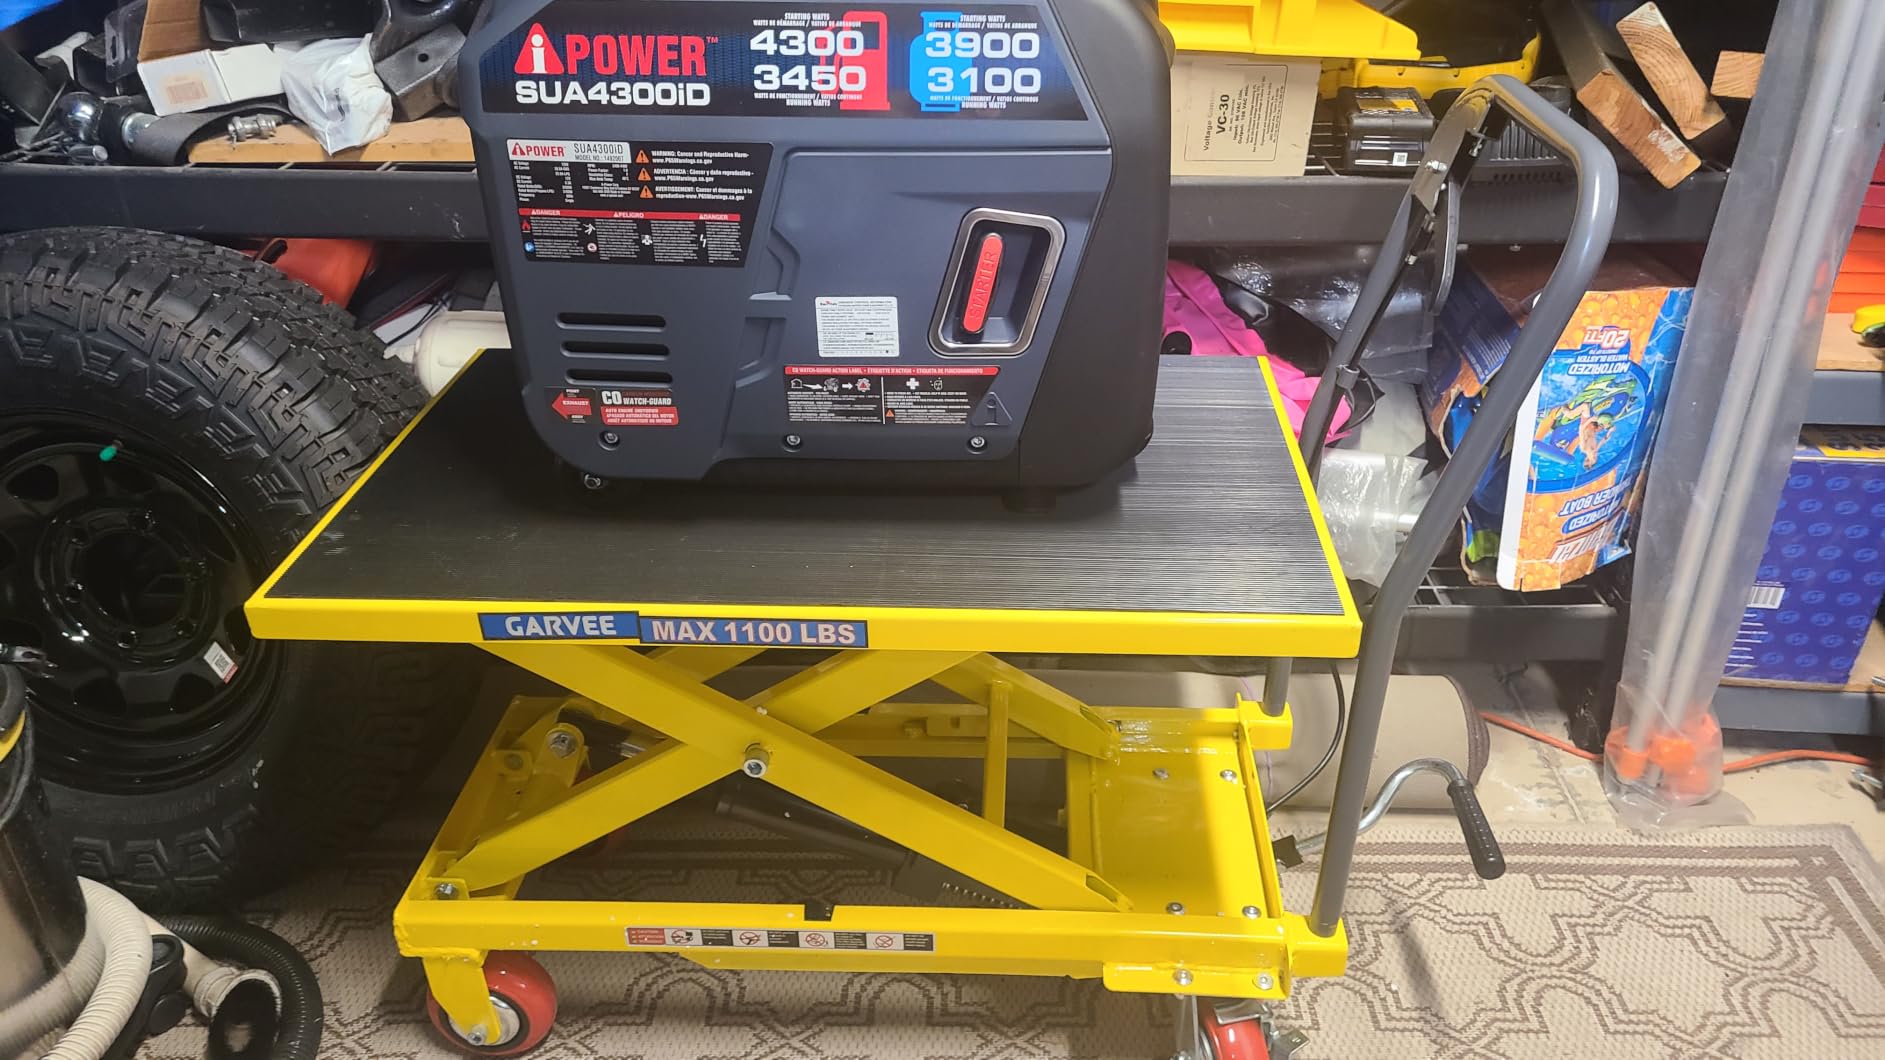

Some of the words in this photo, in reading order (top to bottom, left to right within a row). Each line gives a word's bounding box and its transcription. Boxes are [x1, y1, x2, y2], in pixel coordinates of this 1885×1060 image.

[784, 12, 811, 20] STARTING
[750, 29, 864, 56] 4300
[925, 32, 1040, 59] 3900
[753, 64, 866, 92] 3450
[928, 67, 1041, 93] 3100
[515, 80, 711, 106] SUA4300iD
[813, 99, 831, 107] WATTS
[961, 101, 988, 109] RUNNING
[988, 101, 1007, 109] WATTS
[1216, 94, 1230, 134] VC-30
[1203, 120, 1213, 151] Voltage
[574, 143, 623, 155] SUA4300iD
[575, 154, 591, 162] MODEL
[651, 150, 677, 158] WARNING:
[703, 152, 733, 160] Reproductive
[970, 252, 998, 319] STARTER
[1569, 361, 1630, 375] MOTORIZED
[601, 390, 622, 405] CO
[622, 397, 672, 405] WATCH-GUARD
[1558, 494, 1592, 516] BOAT
[504, 615, 617, 636] GARVEE
[651, 620, 717, 641] MAX
[724, 621, 793, 643] 1100
[800, 623, 856, 644] LBS
